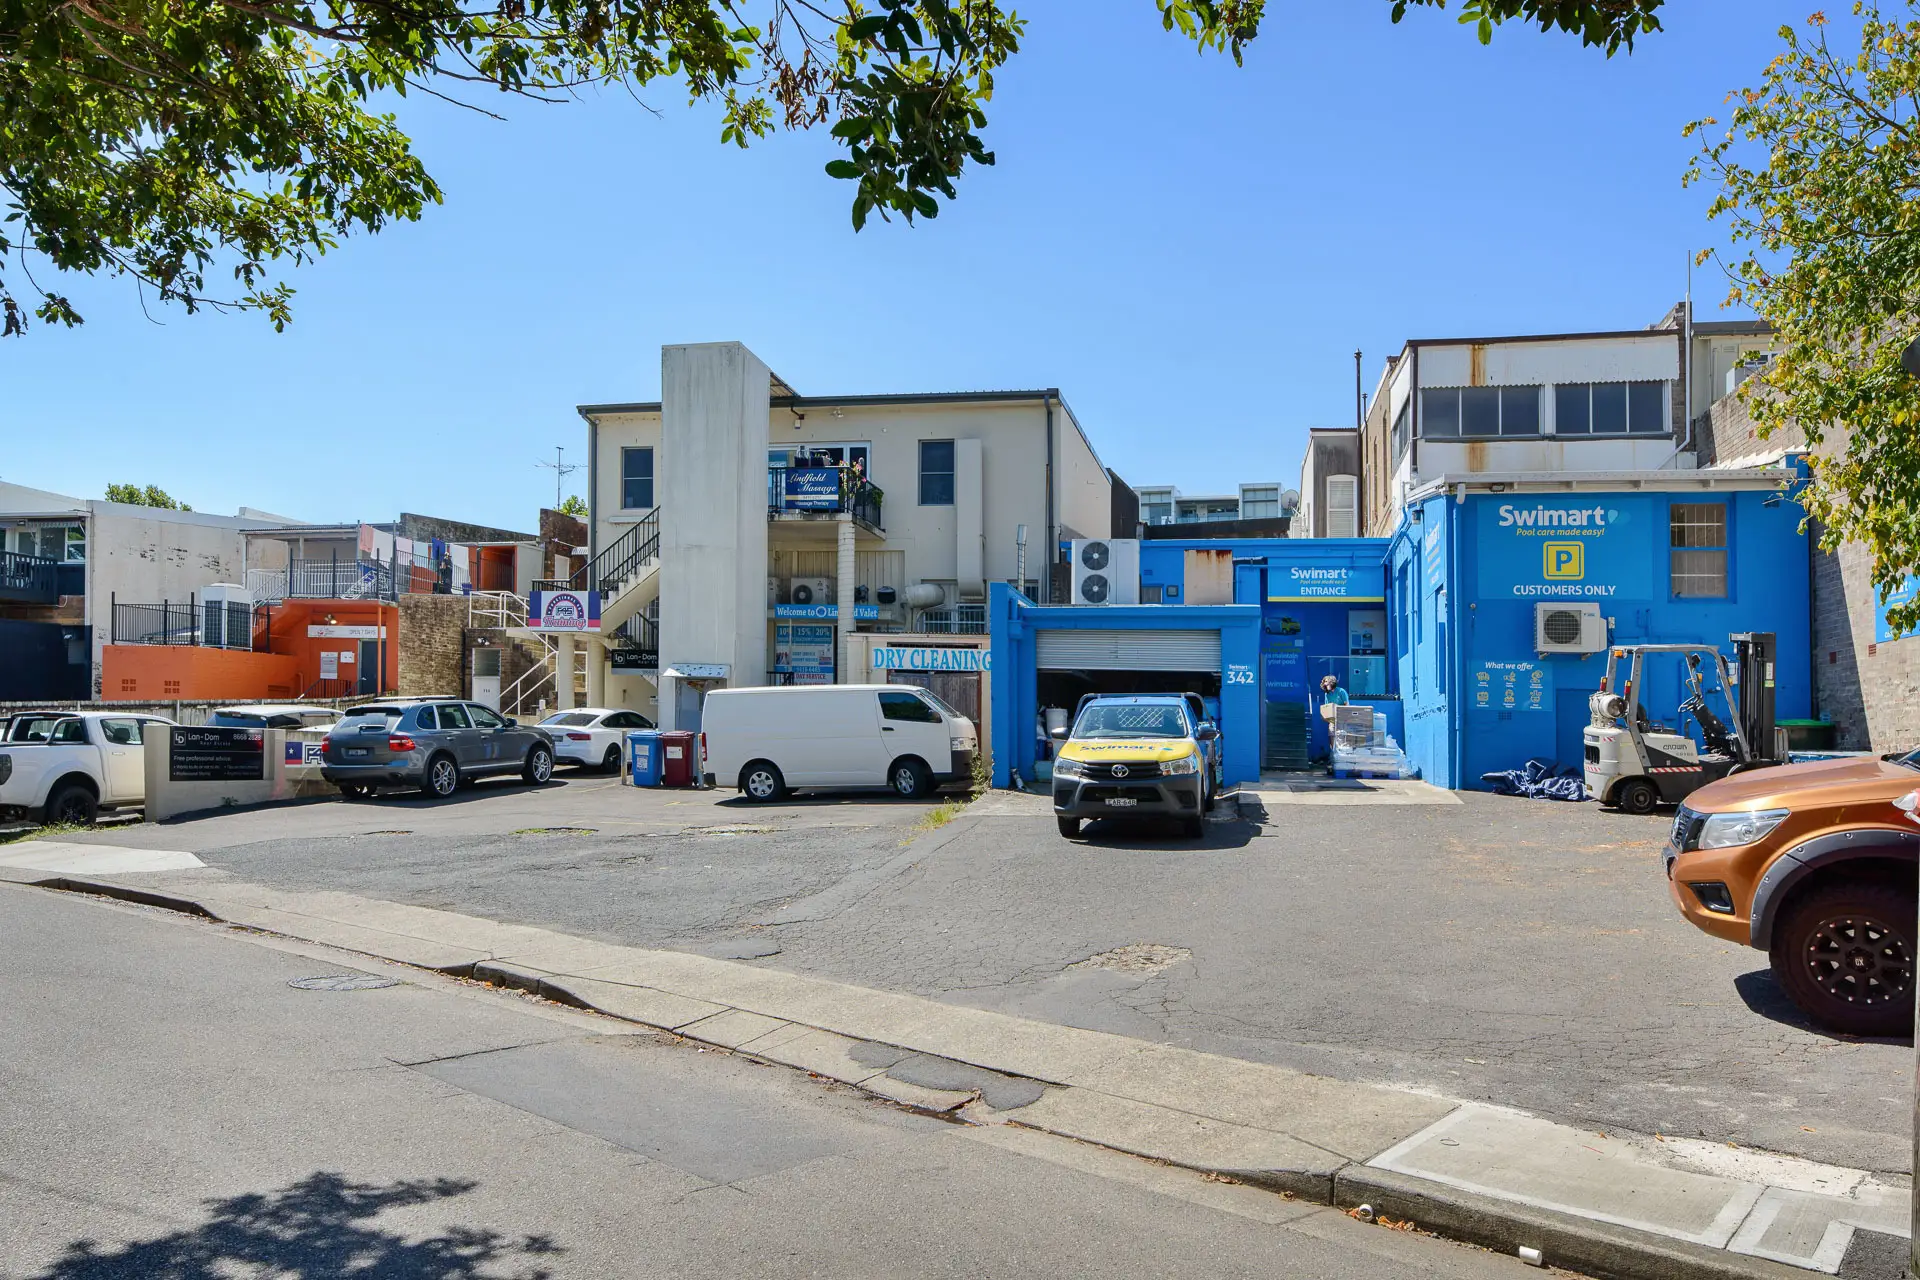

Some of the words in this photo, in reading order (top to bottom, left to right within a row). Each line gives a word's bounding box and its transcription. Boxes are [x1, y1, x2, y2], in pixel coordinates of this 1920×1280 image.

[787, 472, 826, 485] Lindfield
[797, 483, 837, 495] Massage
[1499, 505, 1606, 527] Swimart
[1516, 528, 1535, 537] Pool
[1537, 529, 1555, 537] care
[1557, 528, 1580, 537] made
[1582, 528, 1606, 538] easy!
[1290, 567, 1348, 579] Swimart
[1300, 586, 1347, 596] ENTRANCE
[1513, 585, 1582, 596] CUSTOMERS
[1584, 585, 1616, 596] ONLY
[777, 607, 807, 617] Welcome
[807, 608, 816, 617] to
[859, 608, 878, 618] Valet
[873, 648, 907, 669] DRY
[910, 649, 992, 671] CLEANING
[1485, 662, 1505, 670] What
[1517, 662, 1535, 672] offer
[1227, 671, 1255, 685] 342
